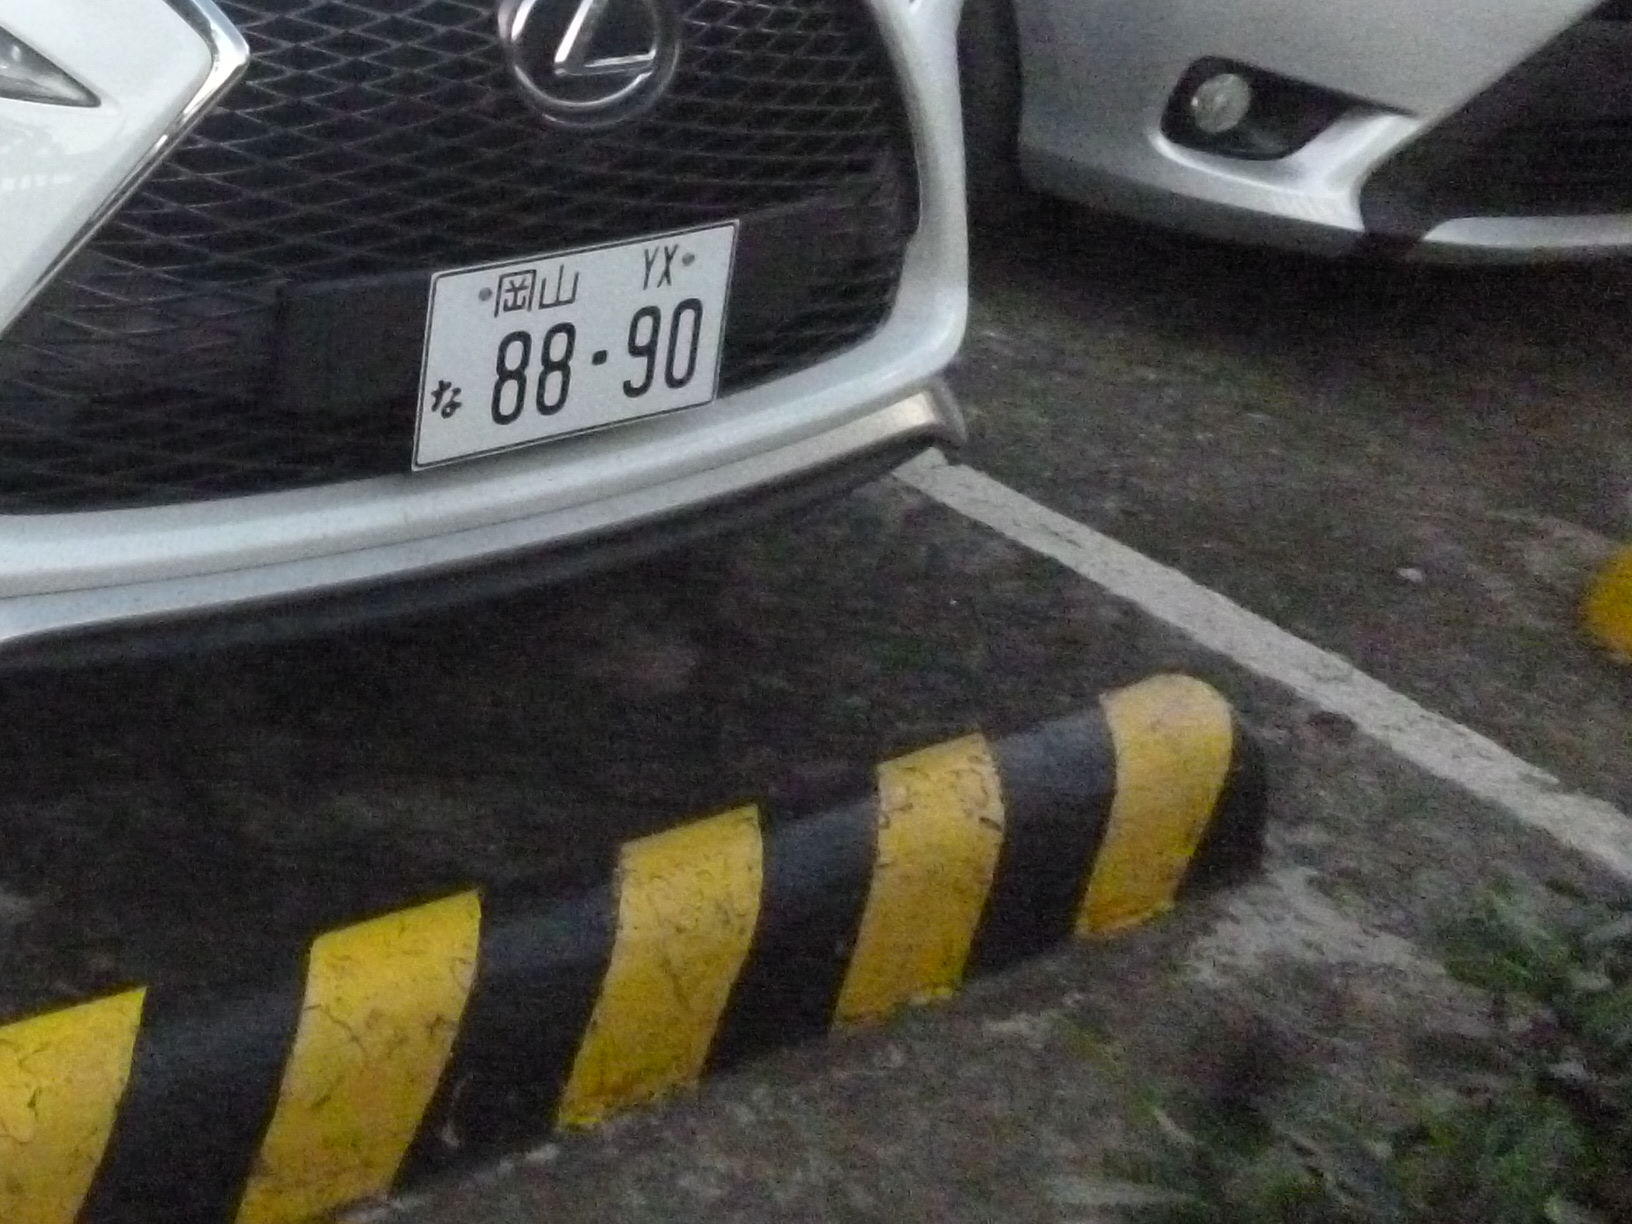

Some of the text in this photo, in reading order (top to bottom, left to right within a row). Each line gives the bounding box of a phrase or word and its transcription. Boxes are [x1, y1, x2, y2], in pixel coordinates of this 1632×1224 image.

[494, 243, 680, 318] 岡山 YX
[430, 297, 704, 426] な 88-90
